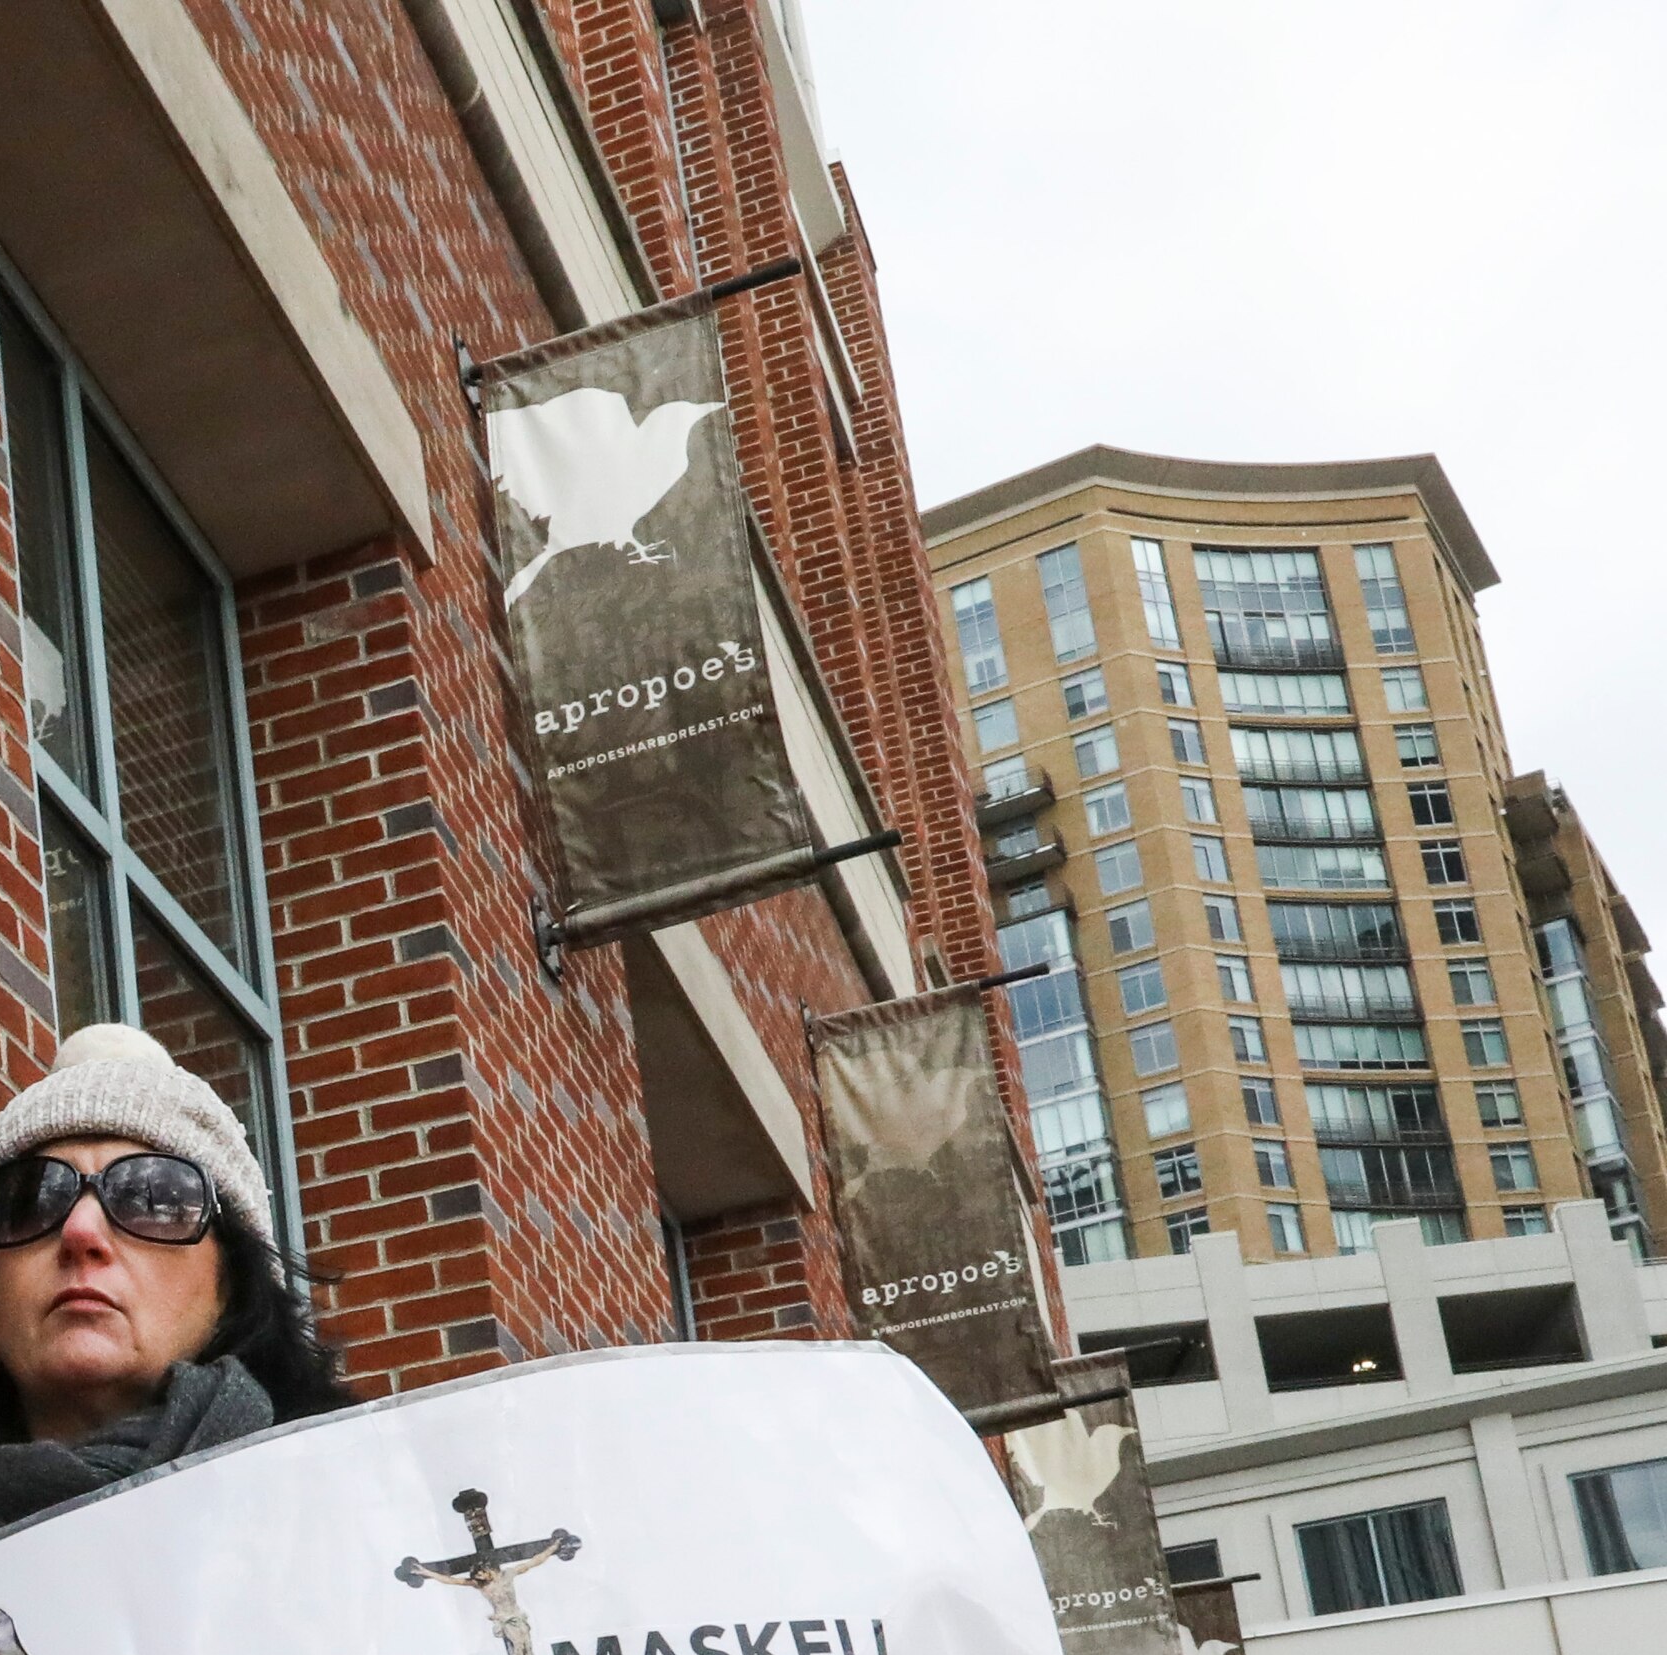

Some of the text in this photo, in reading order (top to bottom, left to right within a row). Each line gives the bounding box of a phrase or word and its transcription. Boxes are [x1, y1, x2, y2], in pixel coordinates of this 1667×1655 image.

[534, 640, 756, 735] apropoe's
[547, 703, 765, 780] APROPOESHARBOREAST.COM
[861, 1250, 1022, 1306] apropoe's
[1052, 1577, 1165, 1614] propoe's
